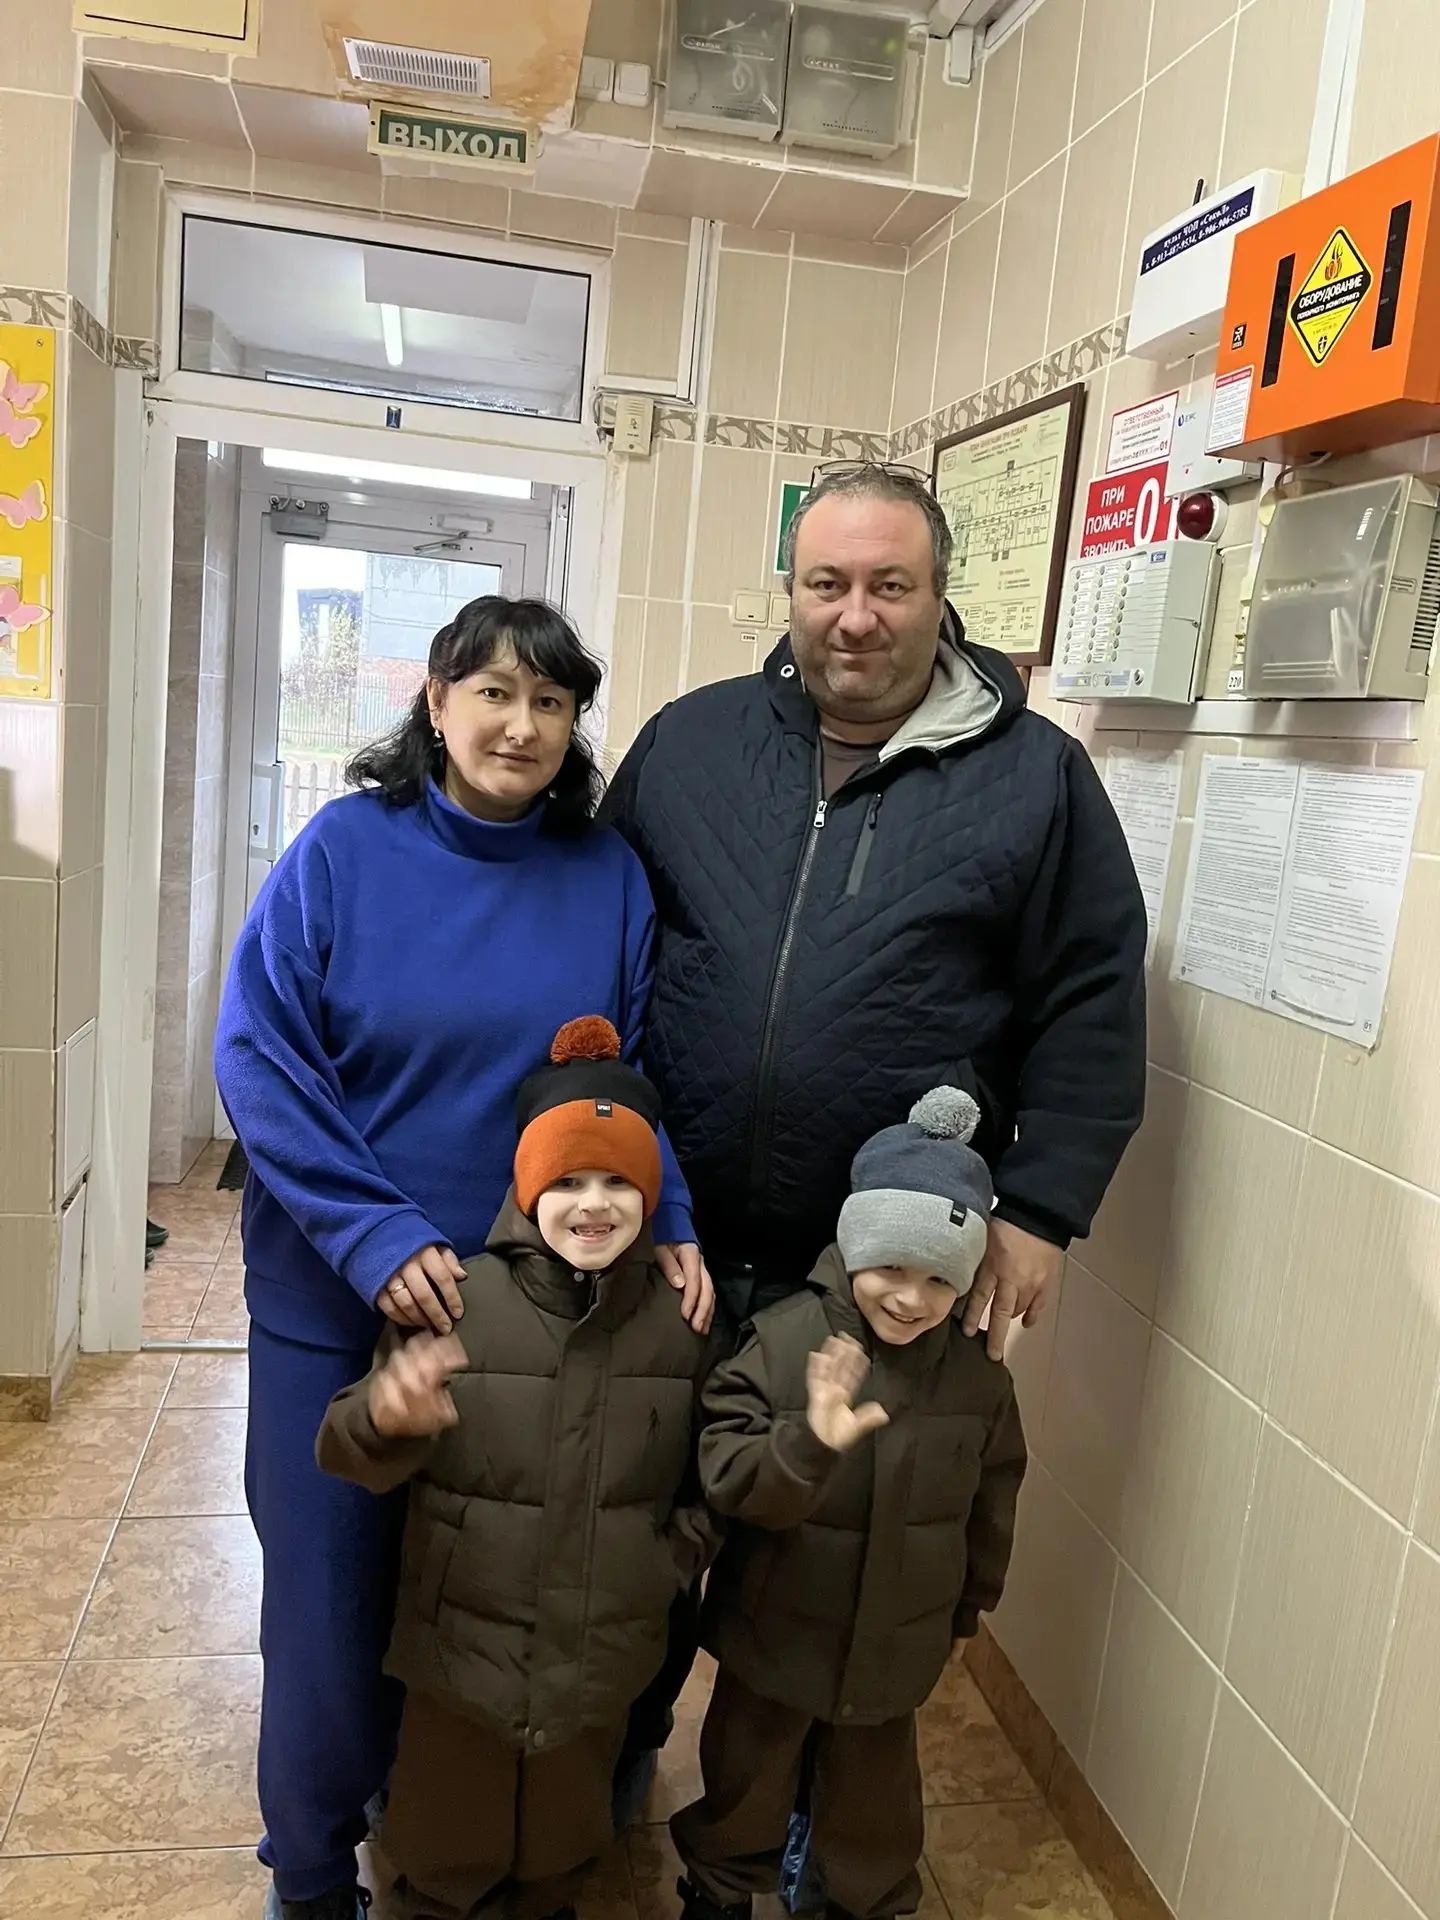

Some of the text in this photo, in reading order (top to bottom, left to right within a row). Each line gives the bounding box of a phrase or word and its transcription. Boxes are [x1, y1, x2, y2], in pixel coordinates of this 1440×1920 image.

[387, 121, 520, 163] ВЫХОД
[1183, 220, 1200, 236] ЧОП
[1299, 274, 1364, 309] ОБОРУДОВАНИЕ
[1101, 484, 1126, 508] ПРИ
[1085, 507, 1136, 536] ПОЖАРЕ
